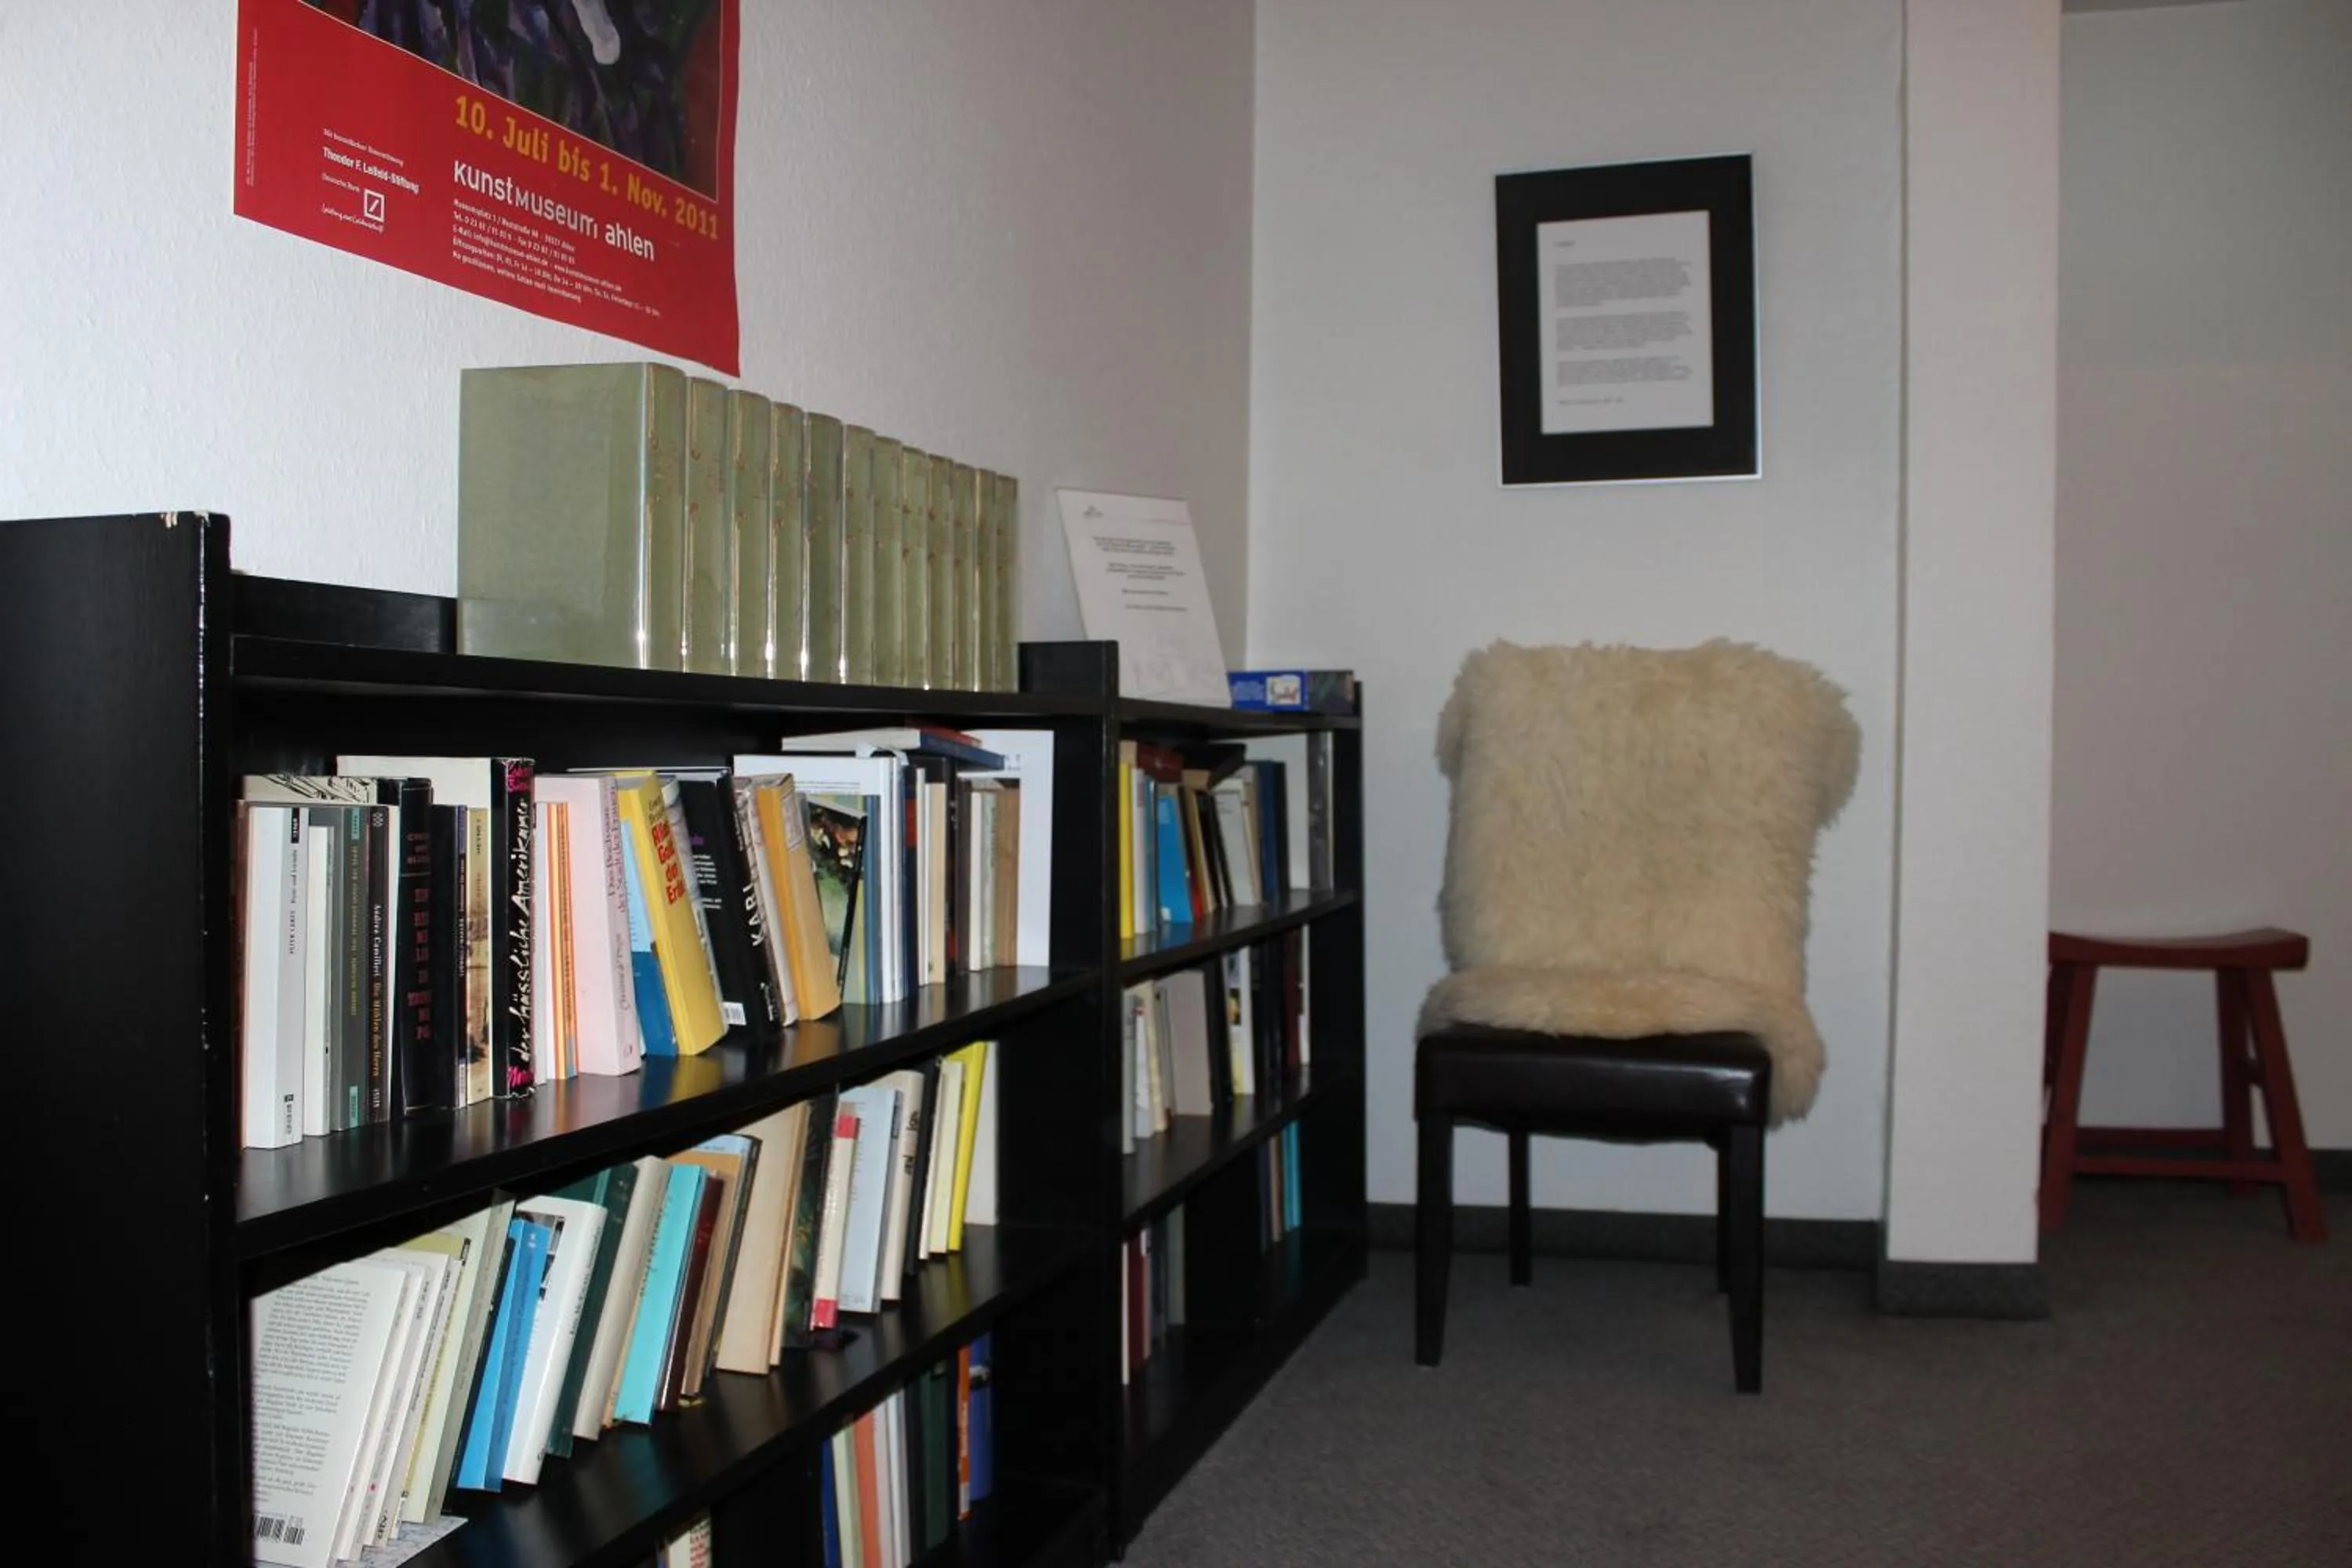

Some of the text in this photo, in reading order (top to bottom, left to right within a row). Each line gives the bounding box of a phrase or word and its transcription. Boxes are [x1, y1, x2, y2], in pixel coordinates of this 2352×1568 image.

[455, 96, 719, 240] 10. Juli bis 1. Nov. 2011
[604, 222, 655, 262] ahlen
[510, 797, 532, 916] Amerikaner
[373, 904, 383, 935] Andrea
[509, 920, 531, 1025] hässliche
[510, 1028, 531, 1063] der
